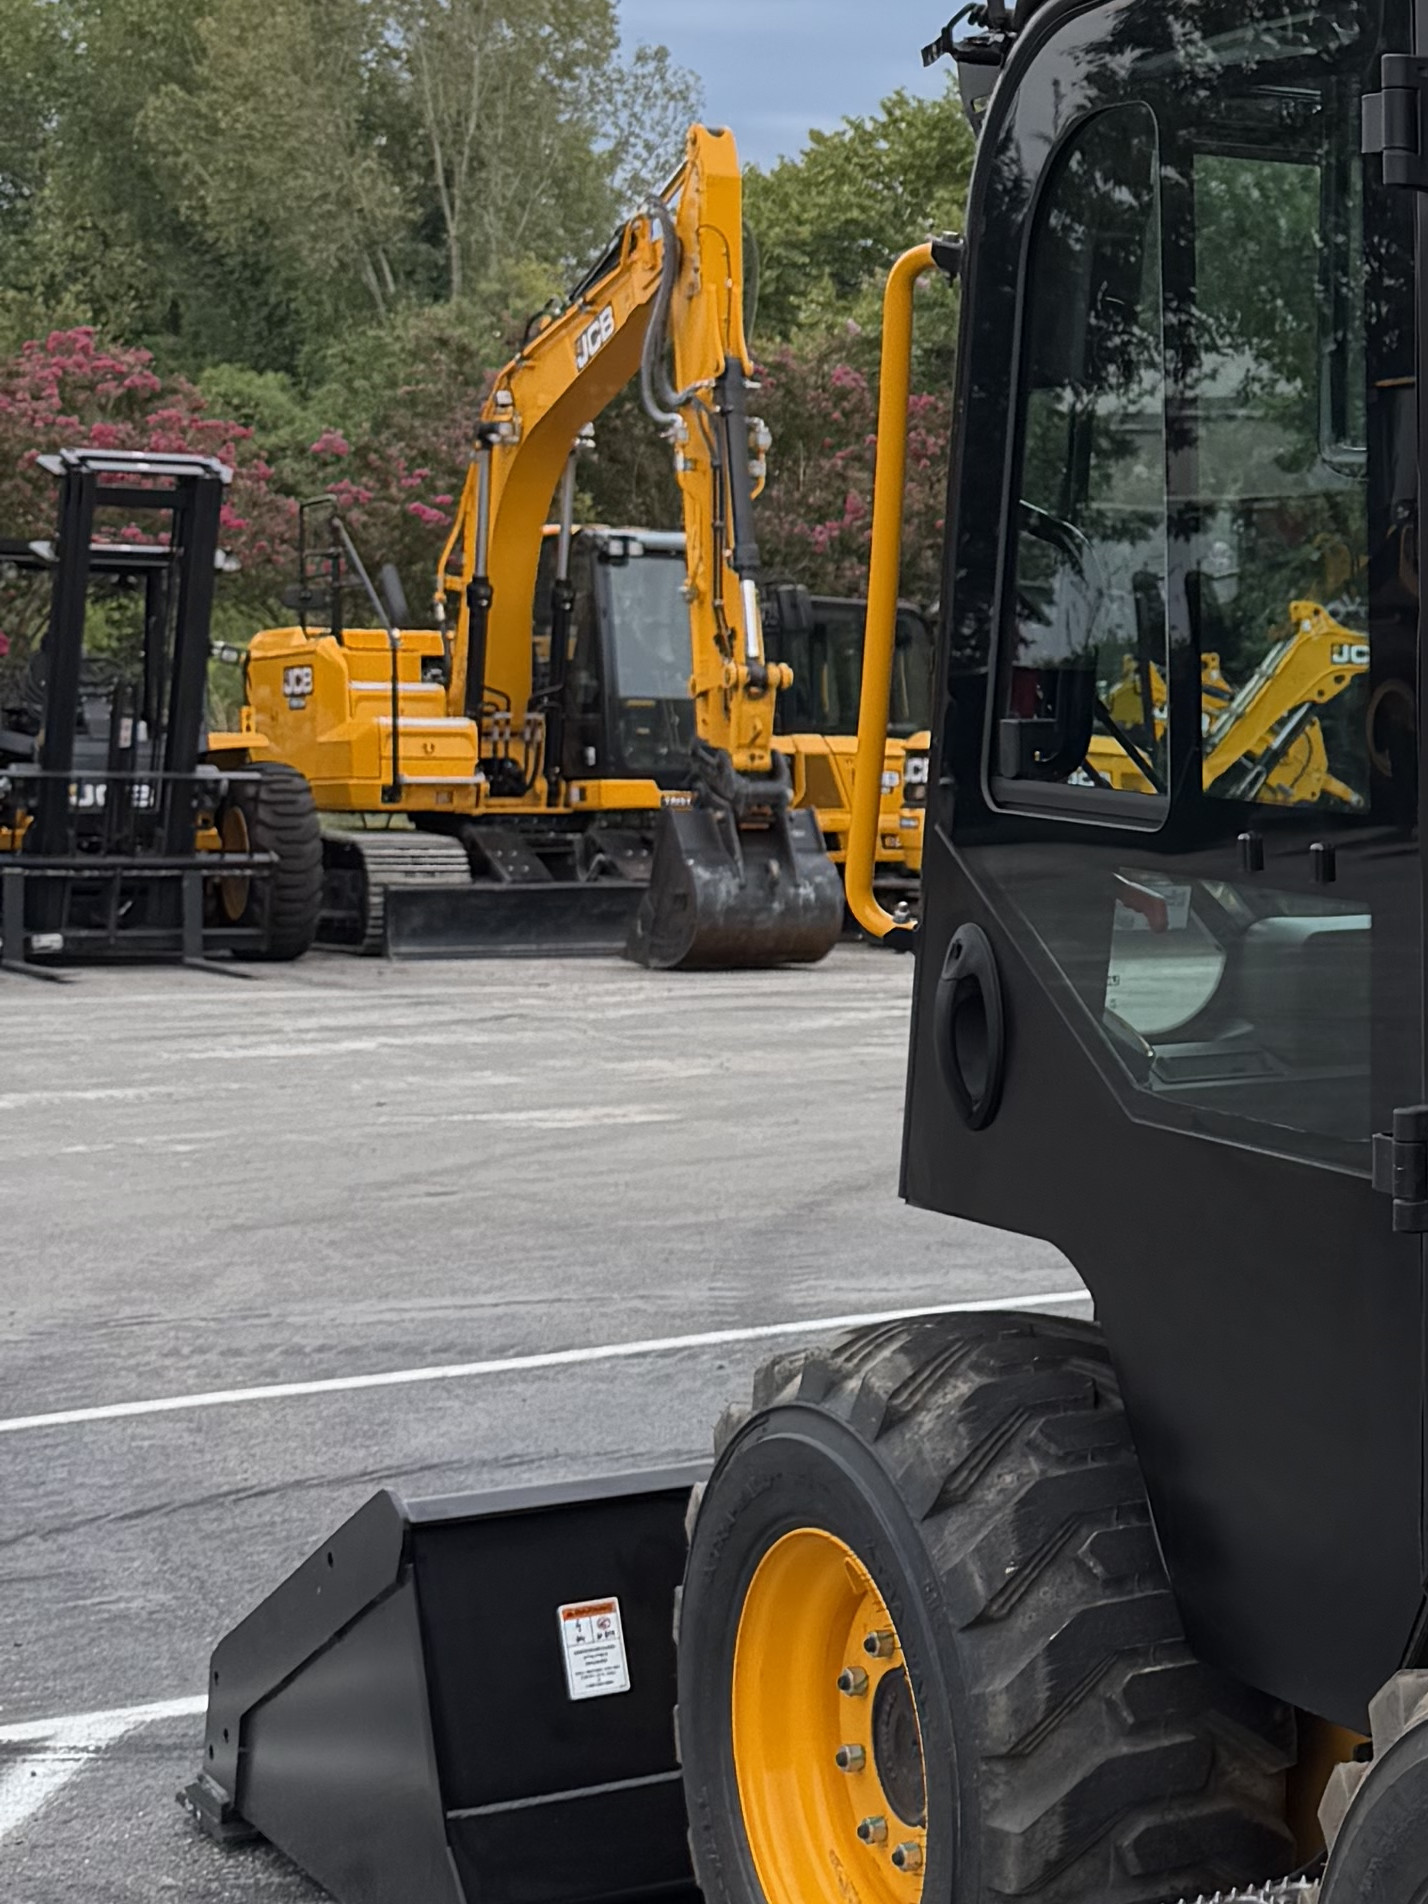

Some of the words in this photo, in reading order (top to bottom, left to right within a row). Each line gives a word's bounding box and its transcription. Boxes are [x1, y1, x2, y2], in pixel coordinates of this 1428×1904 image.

[577, 305, 615, 369] JCB
[1332, 644, 1371, 664] JC
[283, 667, 313, 695] JCB
